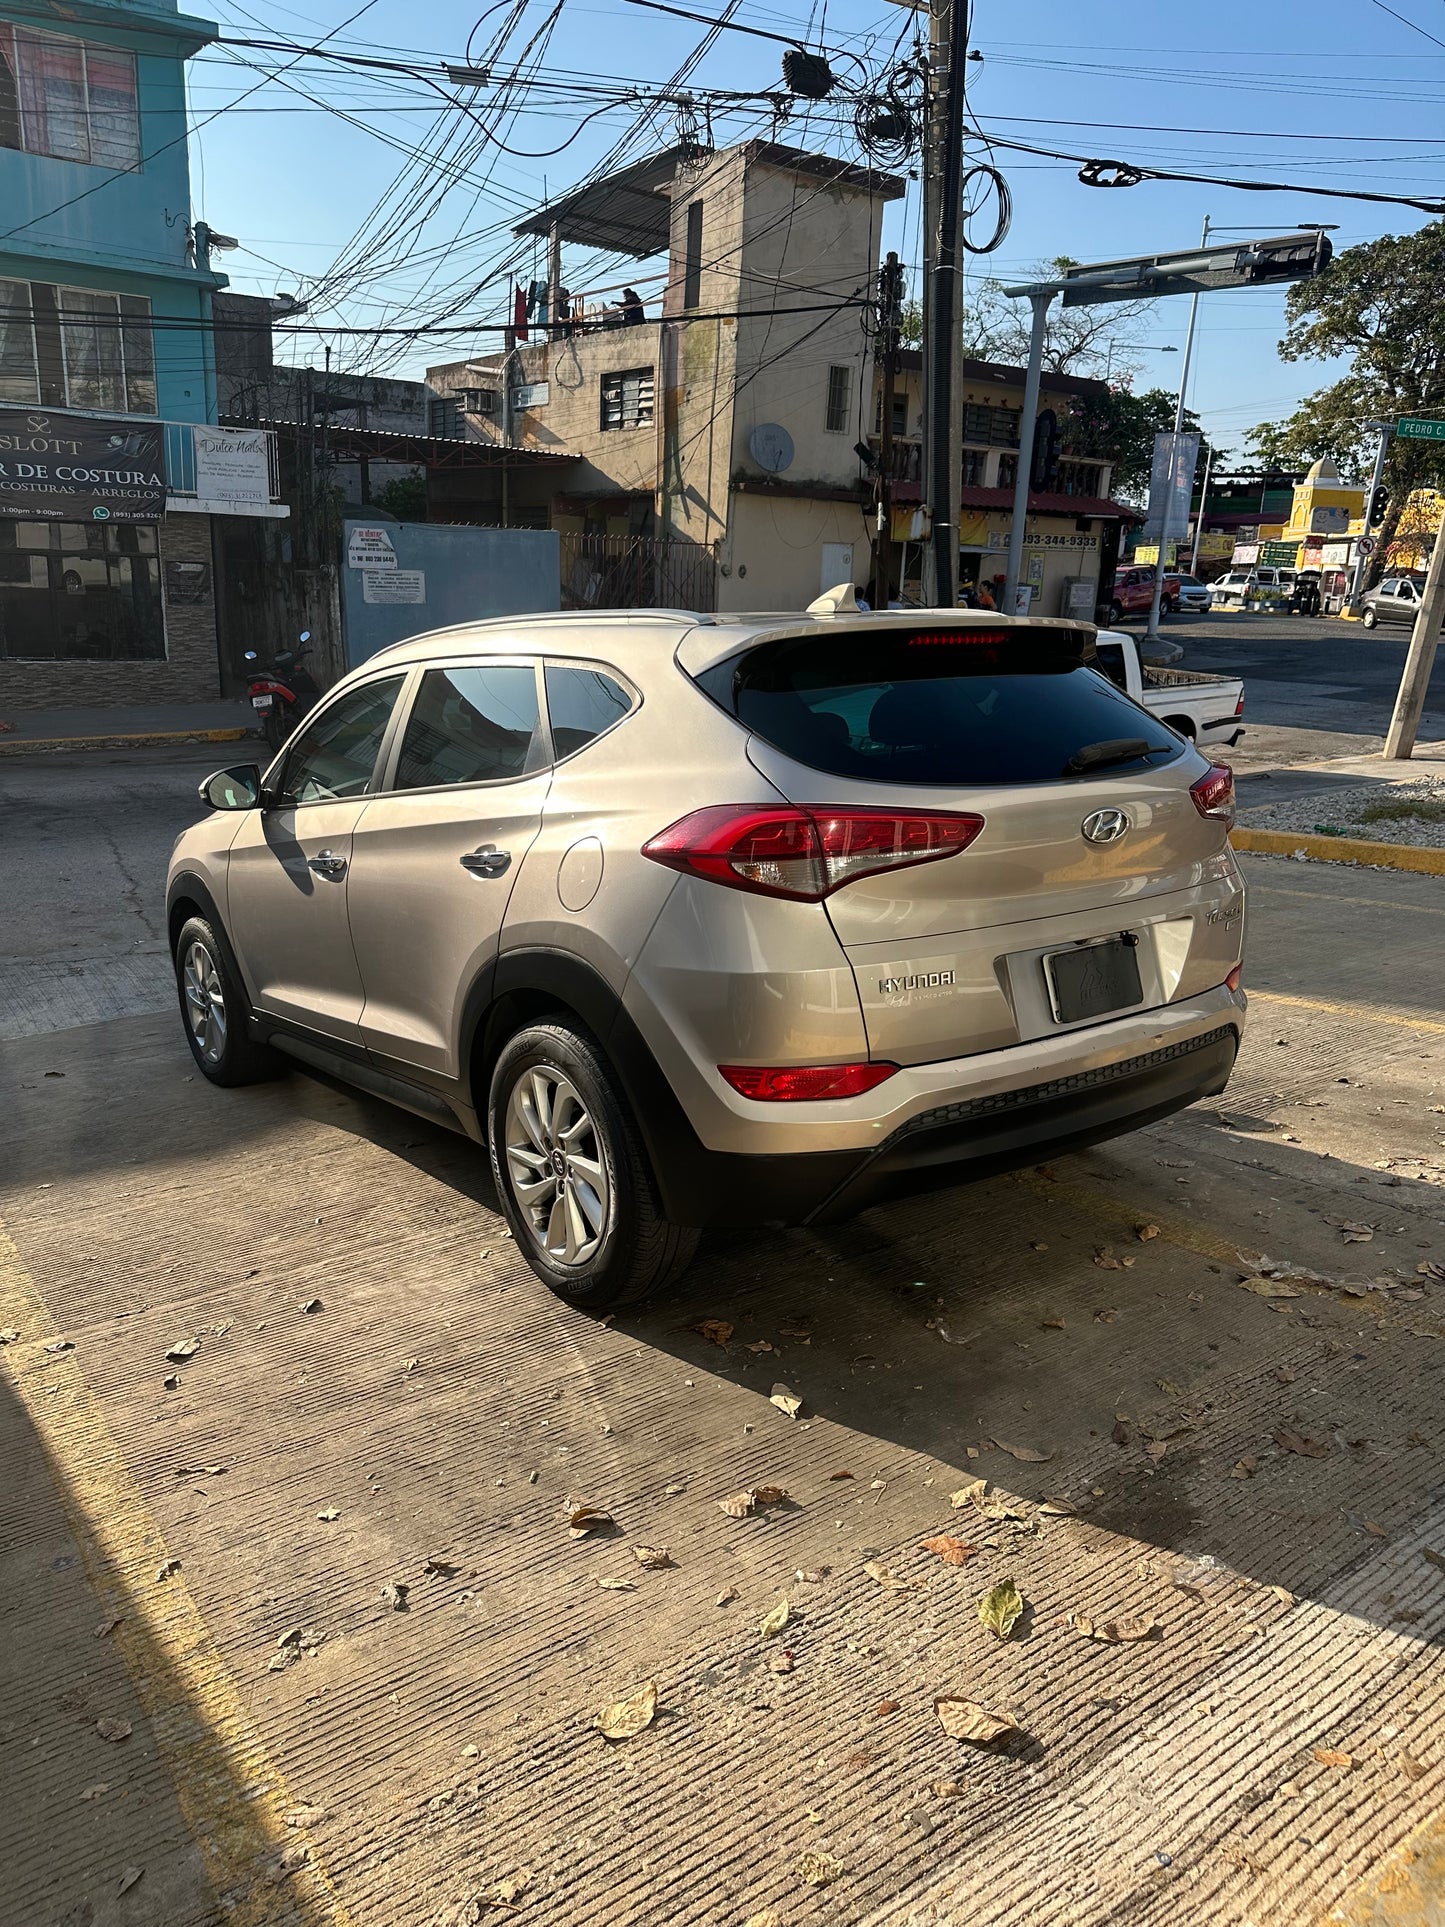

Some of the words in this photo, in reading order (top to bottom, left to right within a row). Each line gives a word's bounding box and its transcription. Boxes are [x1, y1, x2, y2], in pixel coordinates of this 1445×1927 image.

[1404, 423, 1433, 435] PEDRO
[236, 439, 259, 454] Nails
[15, 463, 49, 479] DE
[55, 466, 164, 487] COSTURA
[0, 480, 76, 495] COSTURAS
[91, 487, 160, 500] ARREGLOS
[2, 506, 30, 515] 1:00pm
[36, 509, 64, 517] 9:00pm
[112, 511, 131, 519] (993)
[879, 970, 956, 994] HYUNDAI
